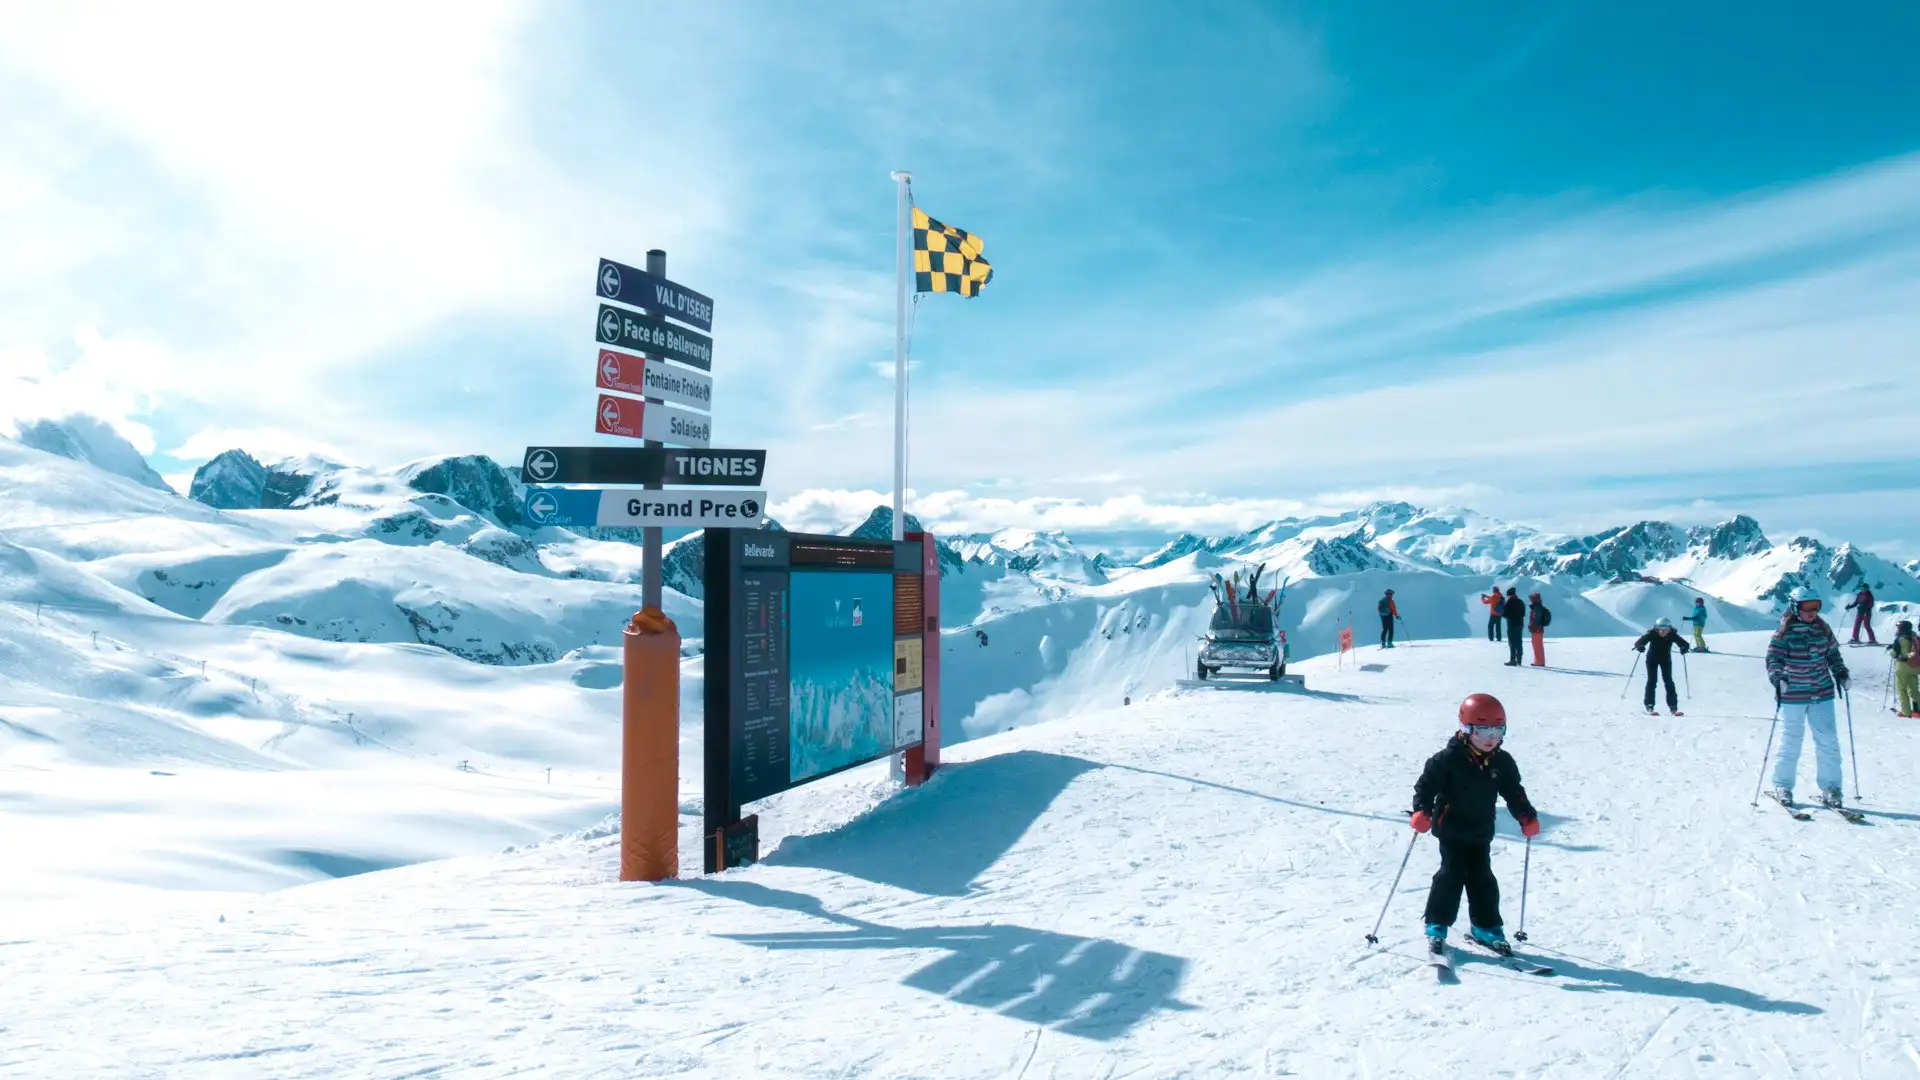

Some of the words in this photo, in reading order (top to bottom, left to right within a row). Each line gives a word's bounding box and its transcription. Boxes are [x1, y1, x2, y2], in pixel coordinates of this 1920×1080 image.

[655, 285, 676, 309] VAL
[624, 318, 651, 343] Face
[652, 326, 665, 347] de
[667, 330, 710, 361] Bellevarde
[645, 368, 680, 393] Fontaine
[682, 377, 703, 400] Froide
[670, 416, 702, 439] Solaise
[675, 456, 758, 476] TIGNES
[627, 498, 692, 517] Grand
[700, 499, 737, 518] Pre
[744, 543, 775, 558] Bellevarde
